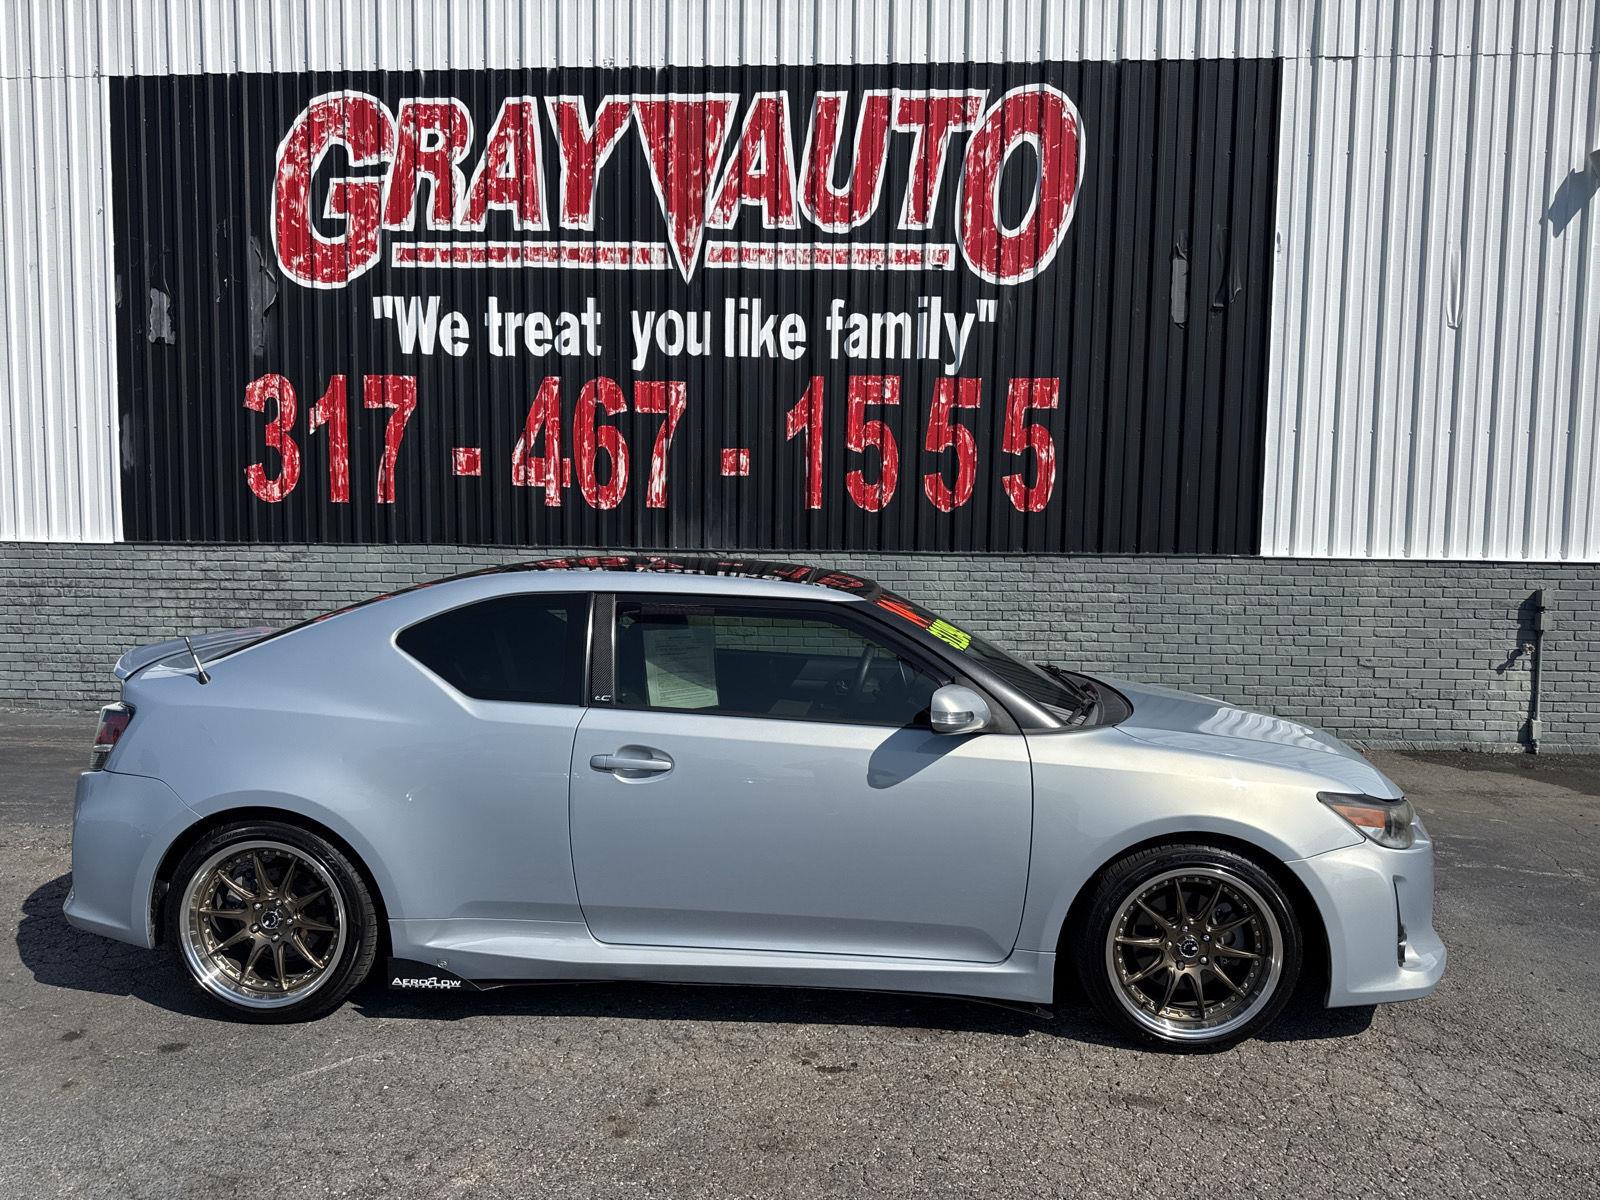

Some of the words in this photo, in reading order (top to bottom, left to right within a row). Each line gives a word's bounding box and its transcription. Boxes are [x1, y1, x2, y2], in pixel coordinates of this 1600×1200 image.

[372, 296, 469, 356] "We
[485, 296, 602, 356] treat
[631, 309, 711, 371] you
[724, 297, 807, 360] like
[826, 296, 998, 375] family"
